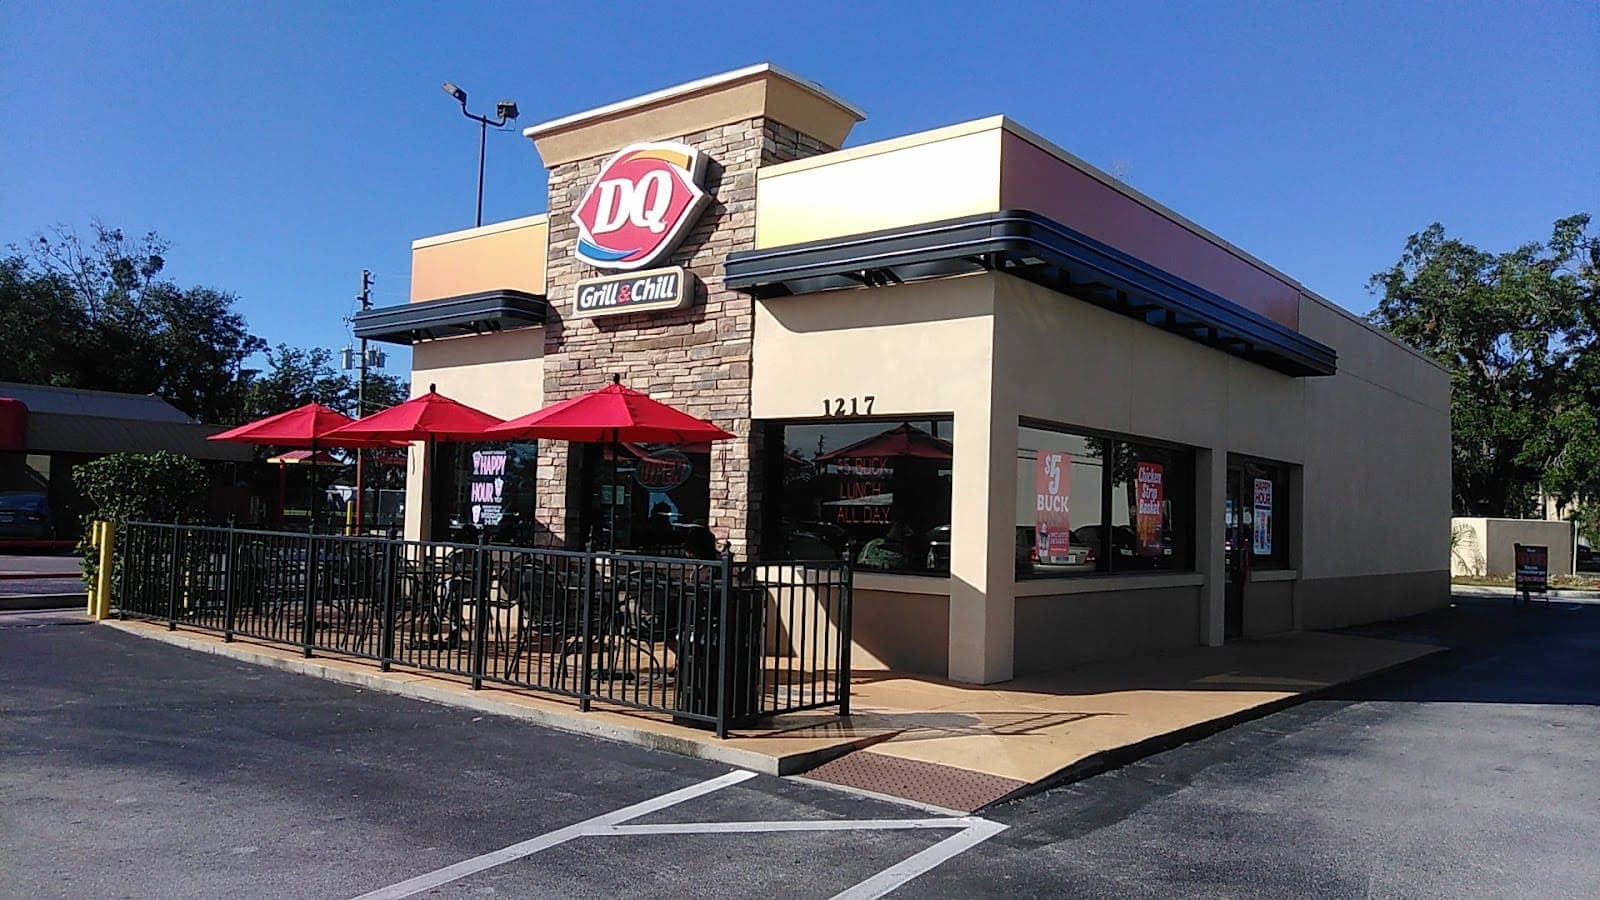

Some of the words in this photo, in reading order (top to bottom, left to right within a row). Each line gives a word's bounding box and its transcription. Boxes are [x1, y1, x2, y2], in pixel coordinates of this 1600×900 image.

[592, 169, 674, 234] DQ
[580, 283, 618, 308] Grill
[619, 284, 631, 303] &
[631, 274, 676, 301] Chill
[822, 395, 875, 417] 1217
[480, 455, 507, 476] HAPPY
[855, 457, 887, 475] BUCK
[1044, 454, 1062, 495] $5
[1139, 466, 1161, 484] Chicken
[471, 482, 494, 503] HOUR
[840, 482, 881, 499] LUNCH
[1142, 484, 1157, 502] Strip
[1037, 494, 1069, 513] BUCK
[1139, 499, 1160, 515] Basket
[836, 506, 857, 524] ALL
[863, 506, 891, 524] DAY
